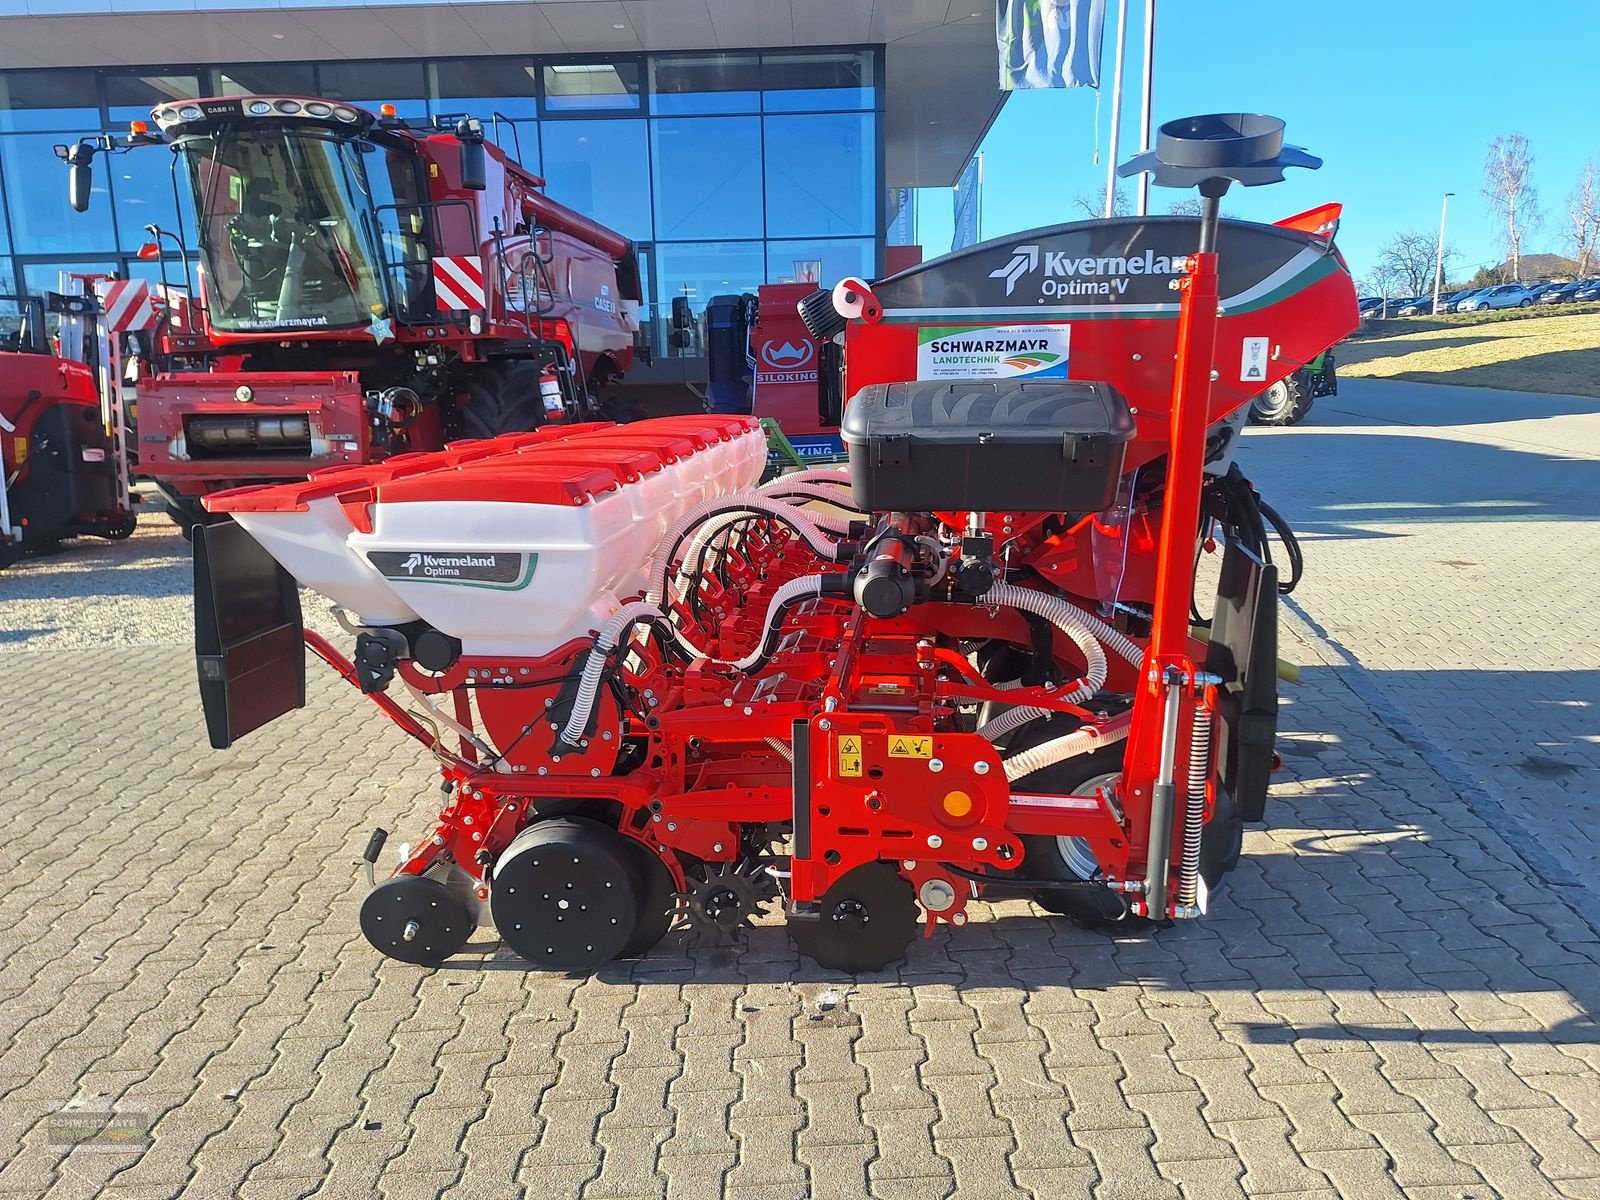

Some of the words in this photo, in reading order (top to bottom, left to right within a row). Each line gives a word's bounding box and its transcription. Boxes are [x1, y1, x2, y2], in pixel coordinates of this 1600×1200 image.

[207, 106, 227, 114] CASE
[1044, 249, 1190, 277] Kvernelan
[1041, 278, 1109, 298] Optima
[1114, 277, 1130, 294] V
[594, 295, 610, 313] CASE
[238, 316, 328, 329] www.schwarzmayr.at
[930, 339, 1049, 353] SCHWARZMAYR
[932, 355, 1001, 365] LANDTECHNIK
[757, 371, 818, 382] SILOKING
[424, 554, 496, 567] Kverneland
[424, 567, 460, 578] Optima
